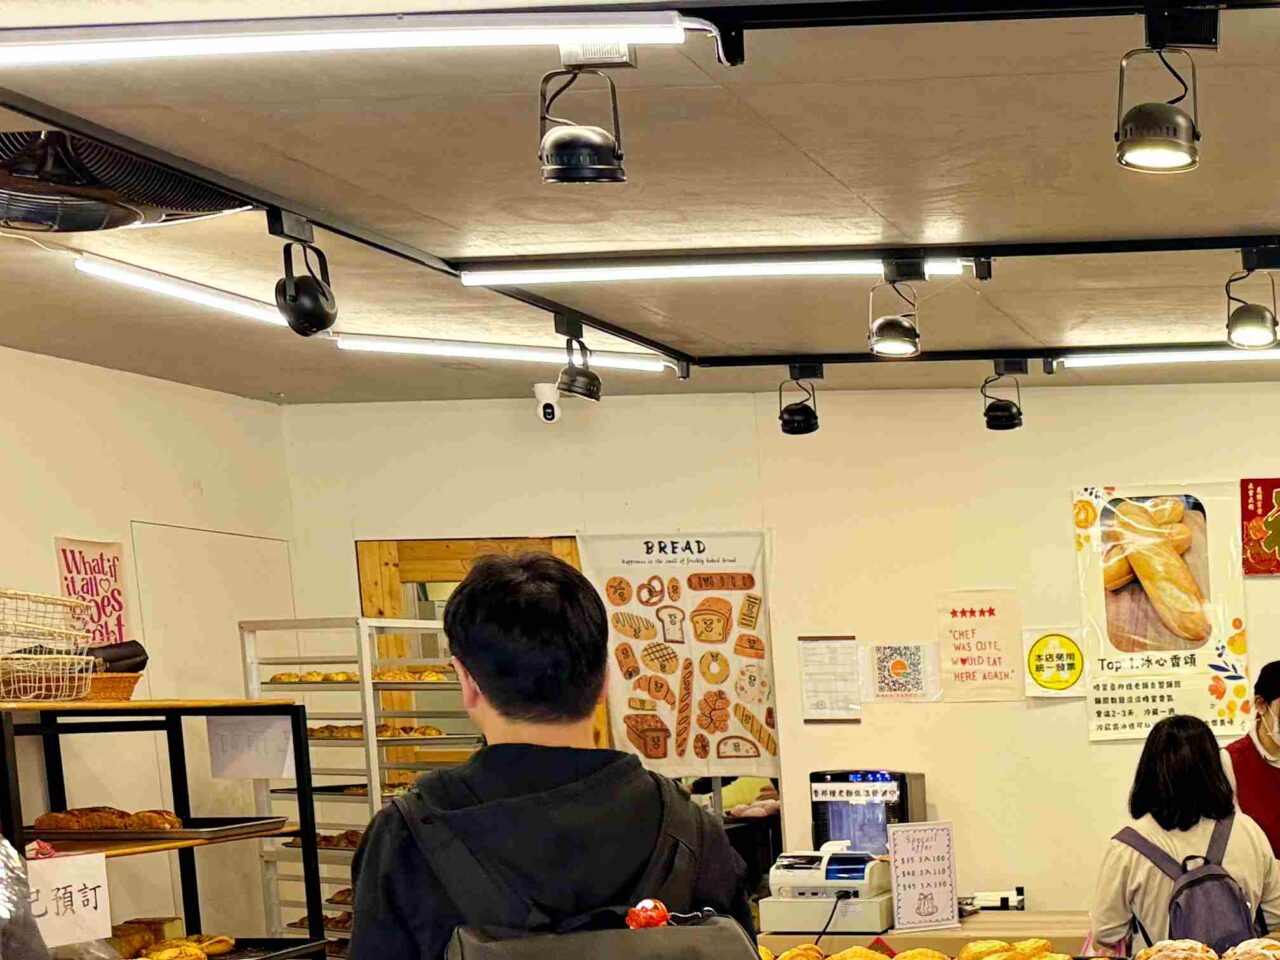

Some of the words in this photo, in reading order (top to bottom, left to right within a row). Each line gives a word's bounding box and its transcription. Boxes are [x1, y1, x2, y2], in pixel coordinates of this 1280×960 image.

[643, 540, 706, 555] BREAD
[61, 548, 108, 576] What
[107, 556, 120, 583] if
[64, 576, 80, 596] it
[80, 576, 99, 597] all
[953, 642, 972, 651] WAS
[986, 656, 1003, 667] EAT
[1097, 658, 1122, 672] Top
[1035, 663, 1077, 673] 統一發票
[954, 671, 977, 682] HERE
